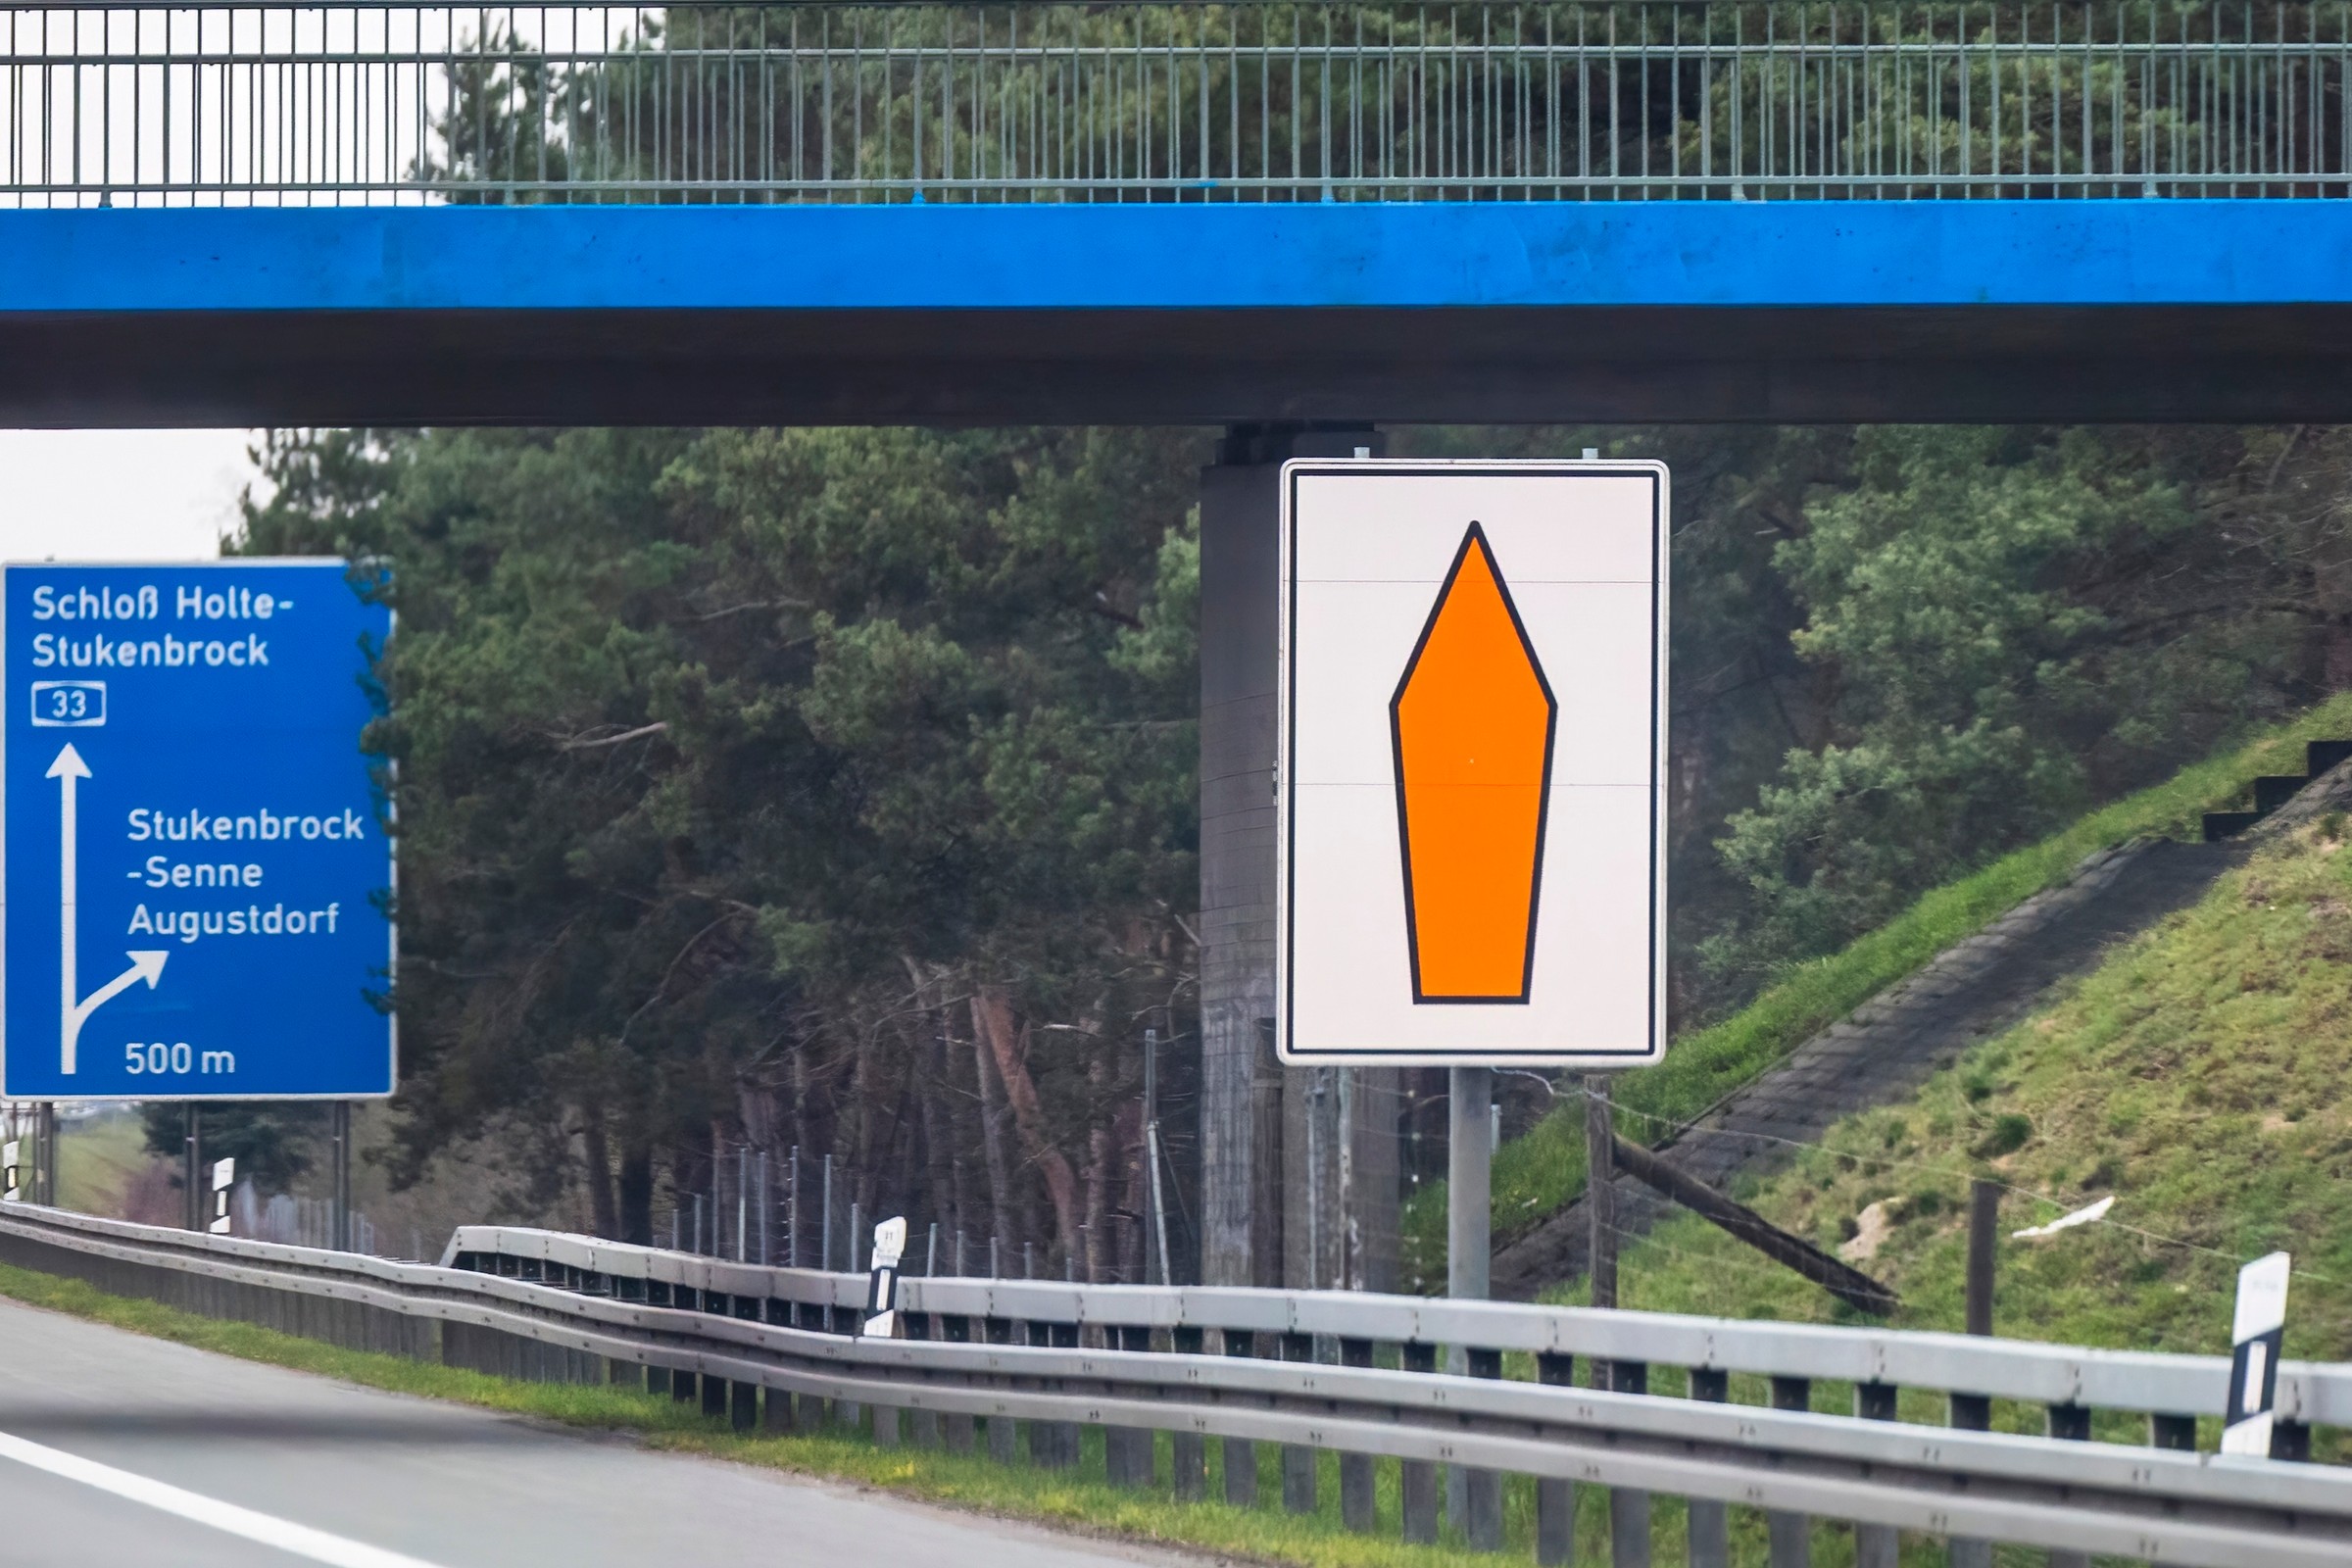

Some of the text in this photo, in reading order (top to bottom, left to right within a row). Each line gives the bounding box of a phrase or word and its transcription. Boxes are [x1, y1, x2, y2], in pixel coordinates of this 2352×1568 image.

[32, 585, 294, 620] Schloß Holte-
[32, 633, 269, 667] Stukenbrock
[51, 689, 87, 718] 33
[127, 808, 365, 841] Stukenbrock
[126, 856, 264, 888] -Senne
[127, 903, 340, 944] Augustdorf
[125, 1042, 236, 1075] 500 m
